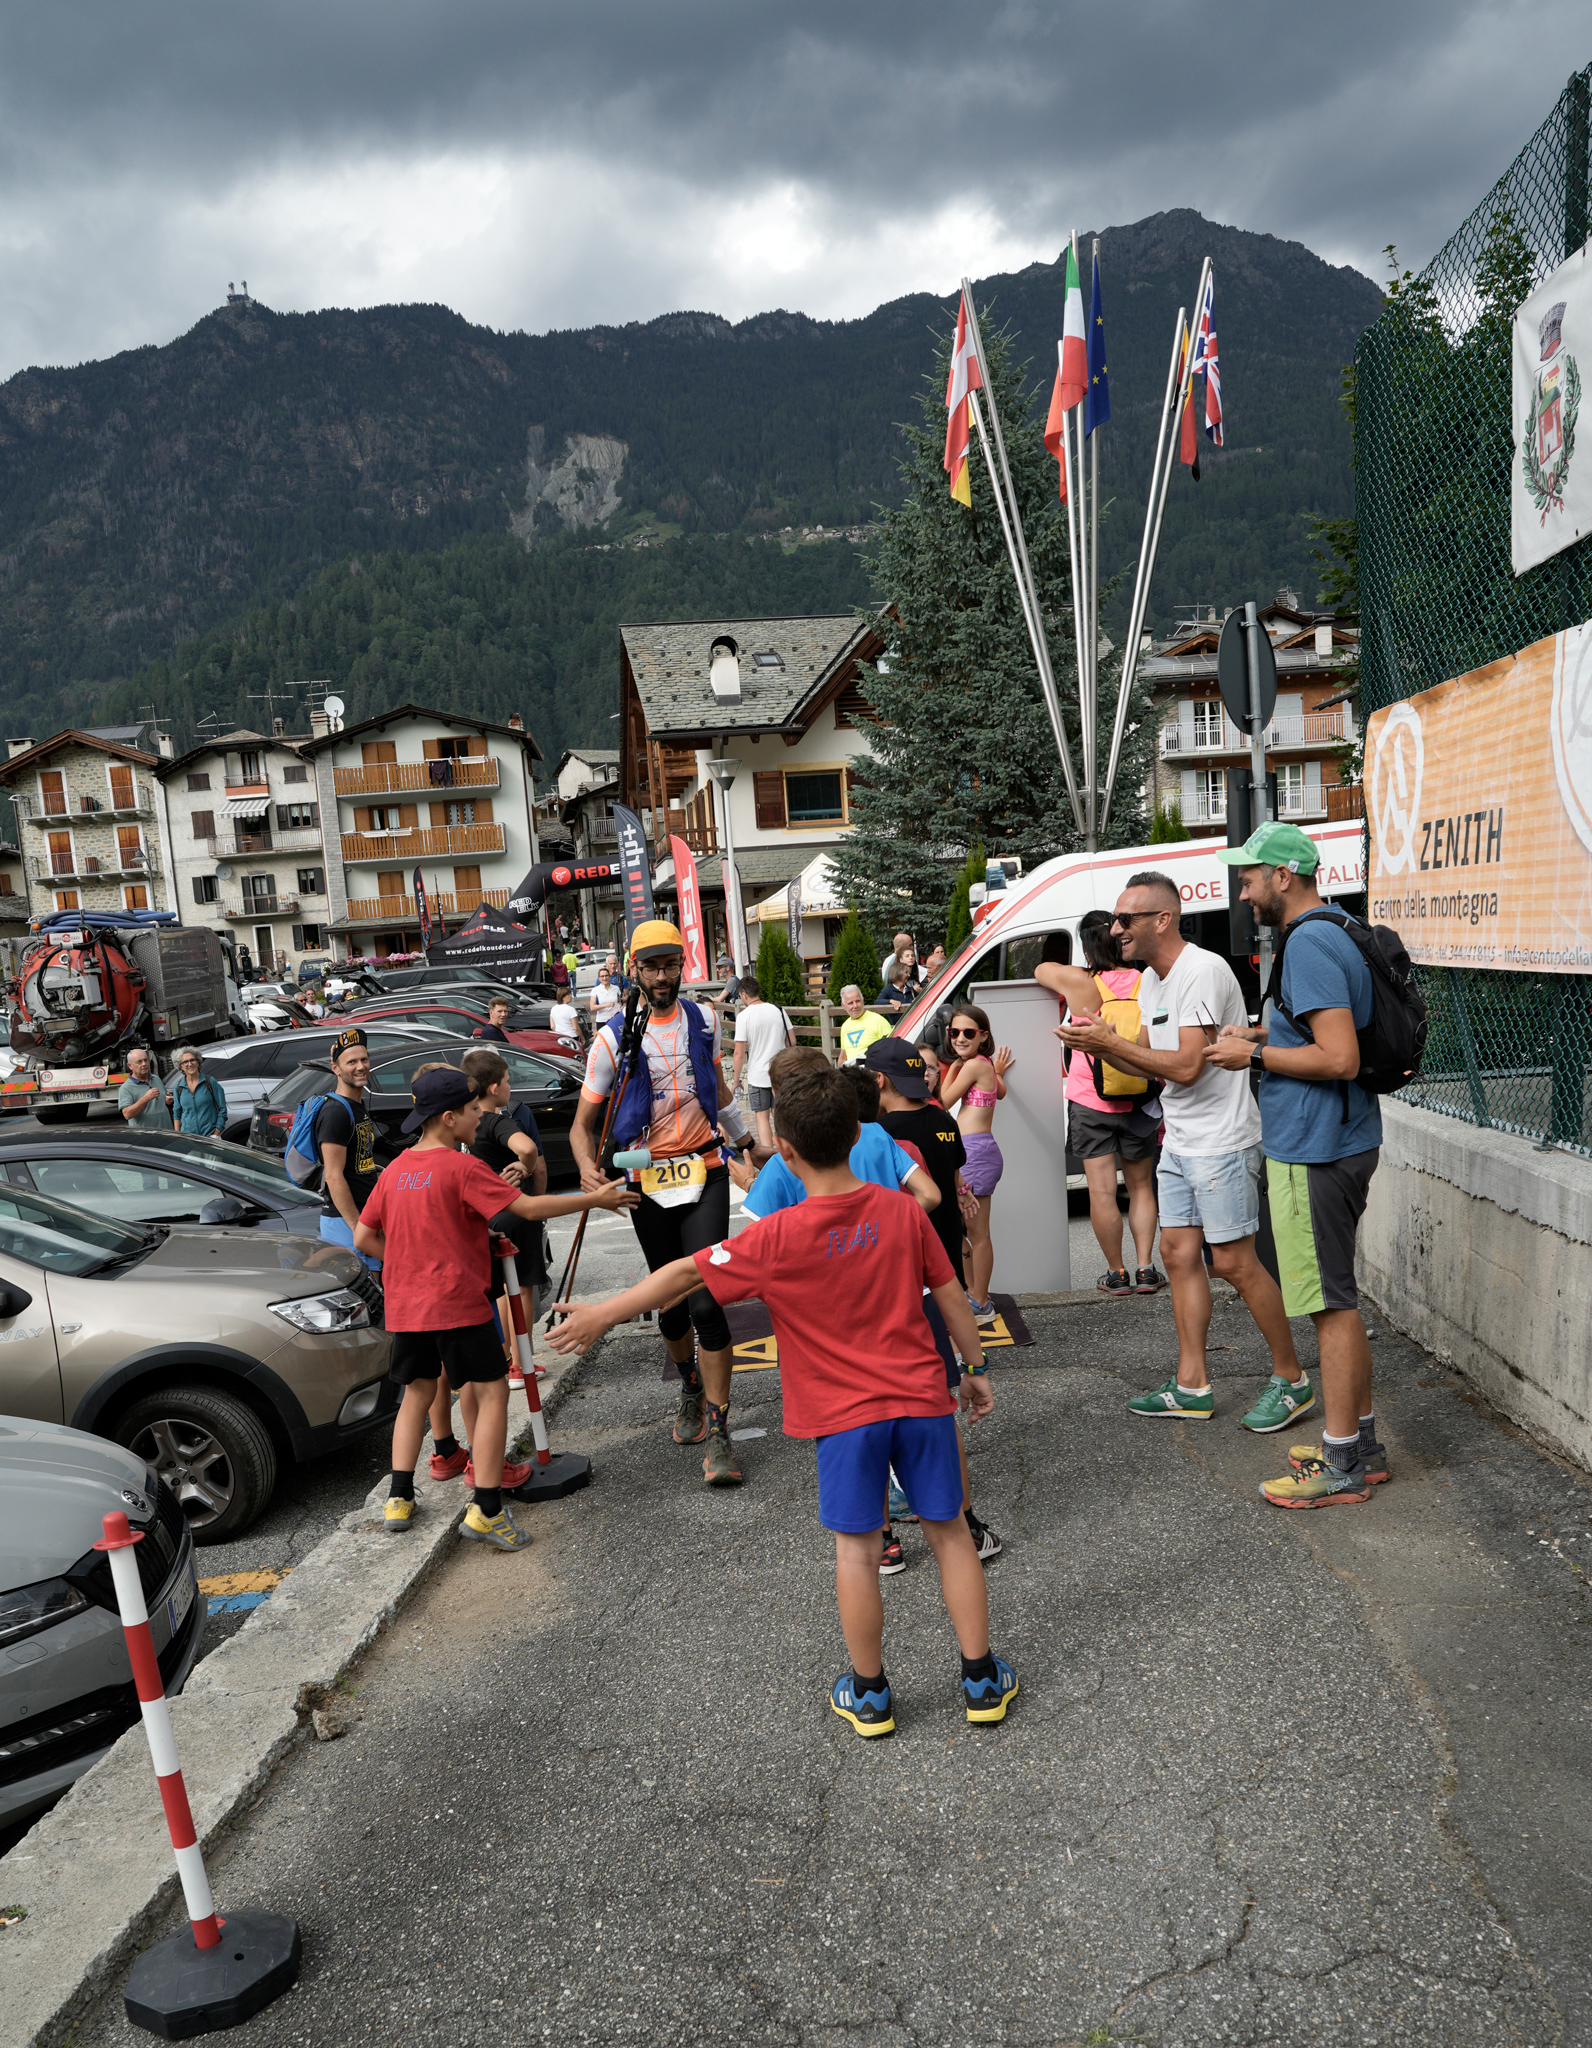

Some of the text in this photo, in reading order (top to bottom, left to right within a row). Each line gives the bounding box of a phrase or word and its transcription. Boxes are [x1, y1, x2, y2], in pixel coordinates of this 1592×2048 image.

[1420, 807, 1503, 871] ZENITH
[1373, 890, 1498, 926] centro della montagna
[396, 1171, 433, 1190] ENEA
[655, 1162, 691, 1184] 210
[826, 1220, 878, 1258] IVAN
[1326, 1476, 1353, 1492] HOKA
